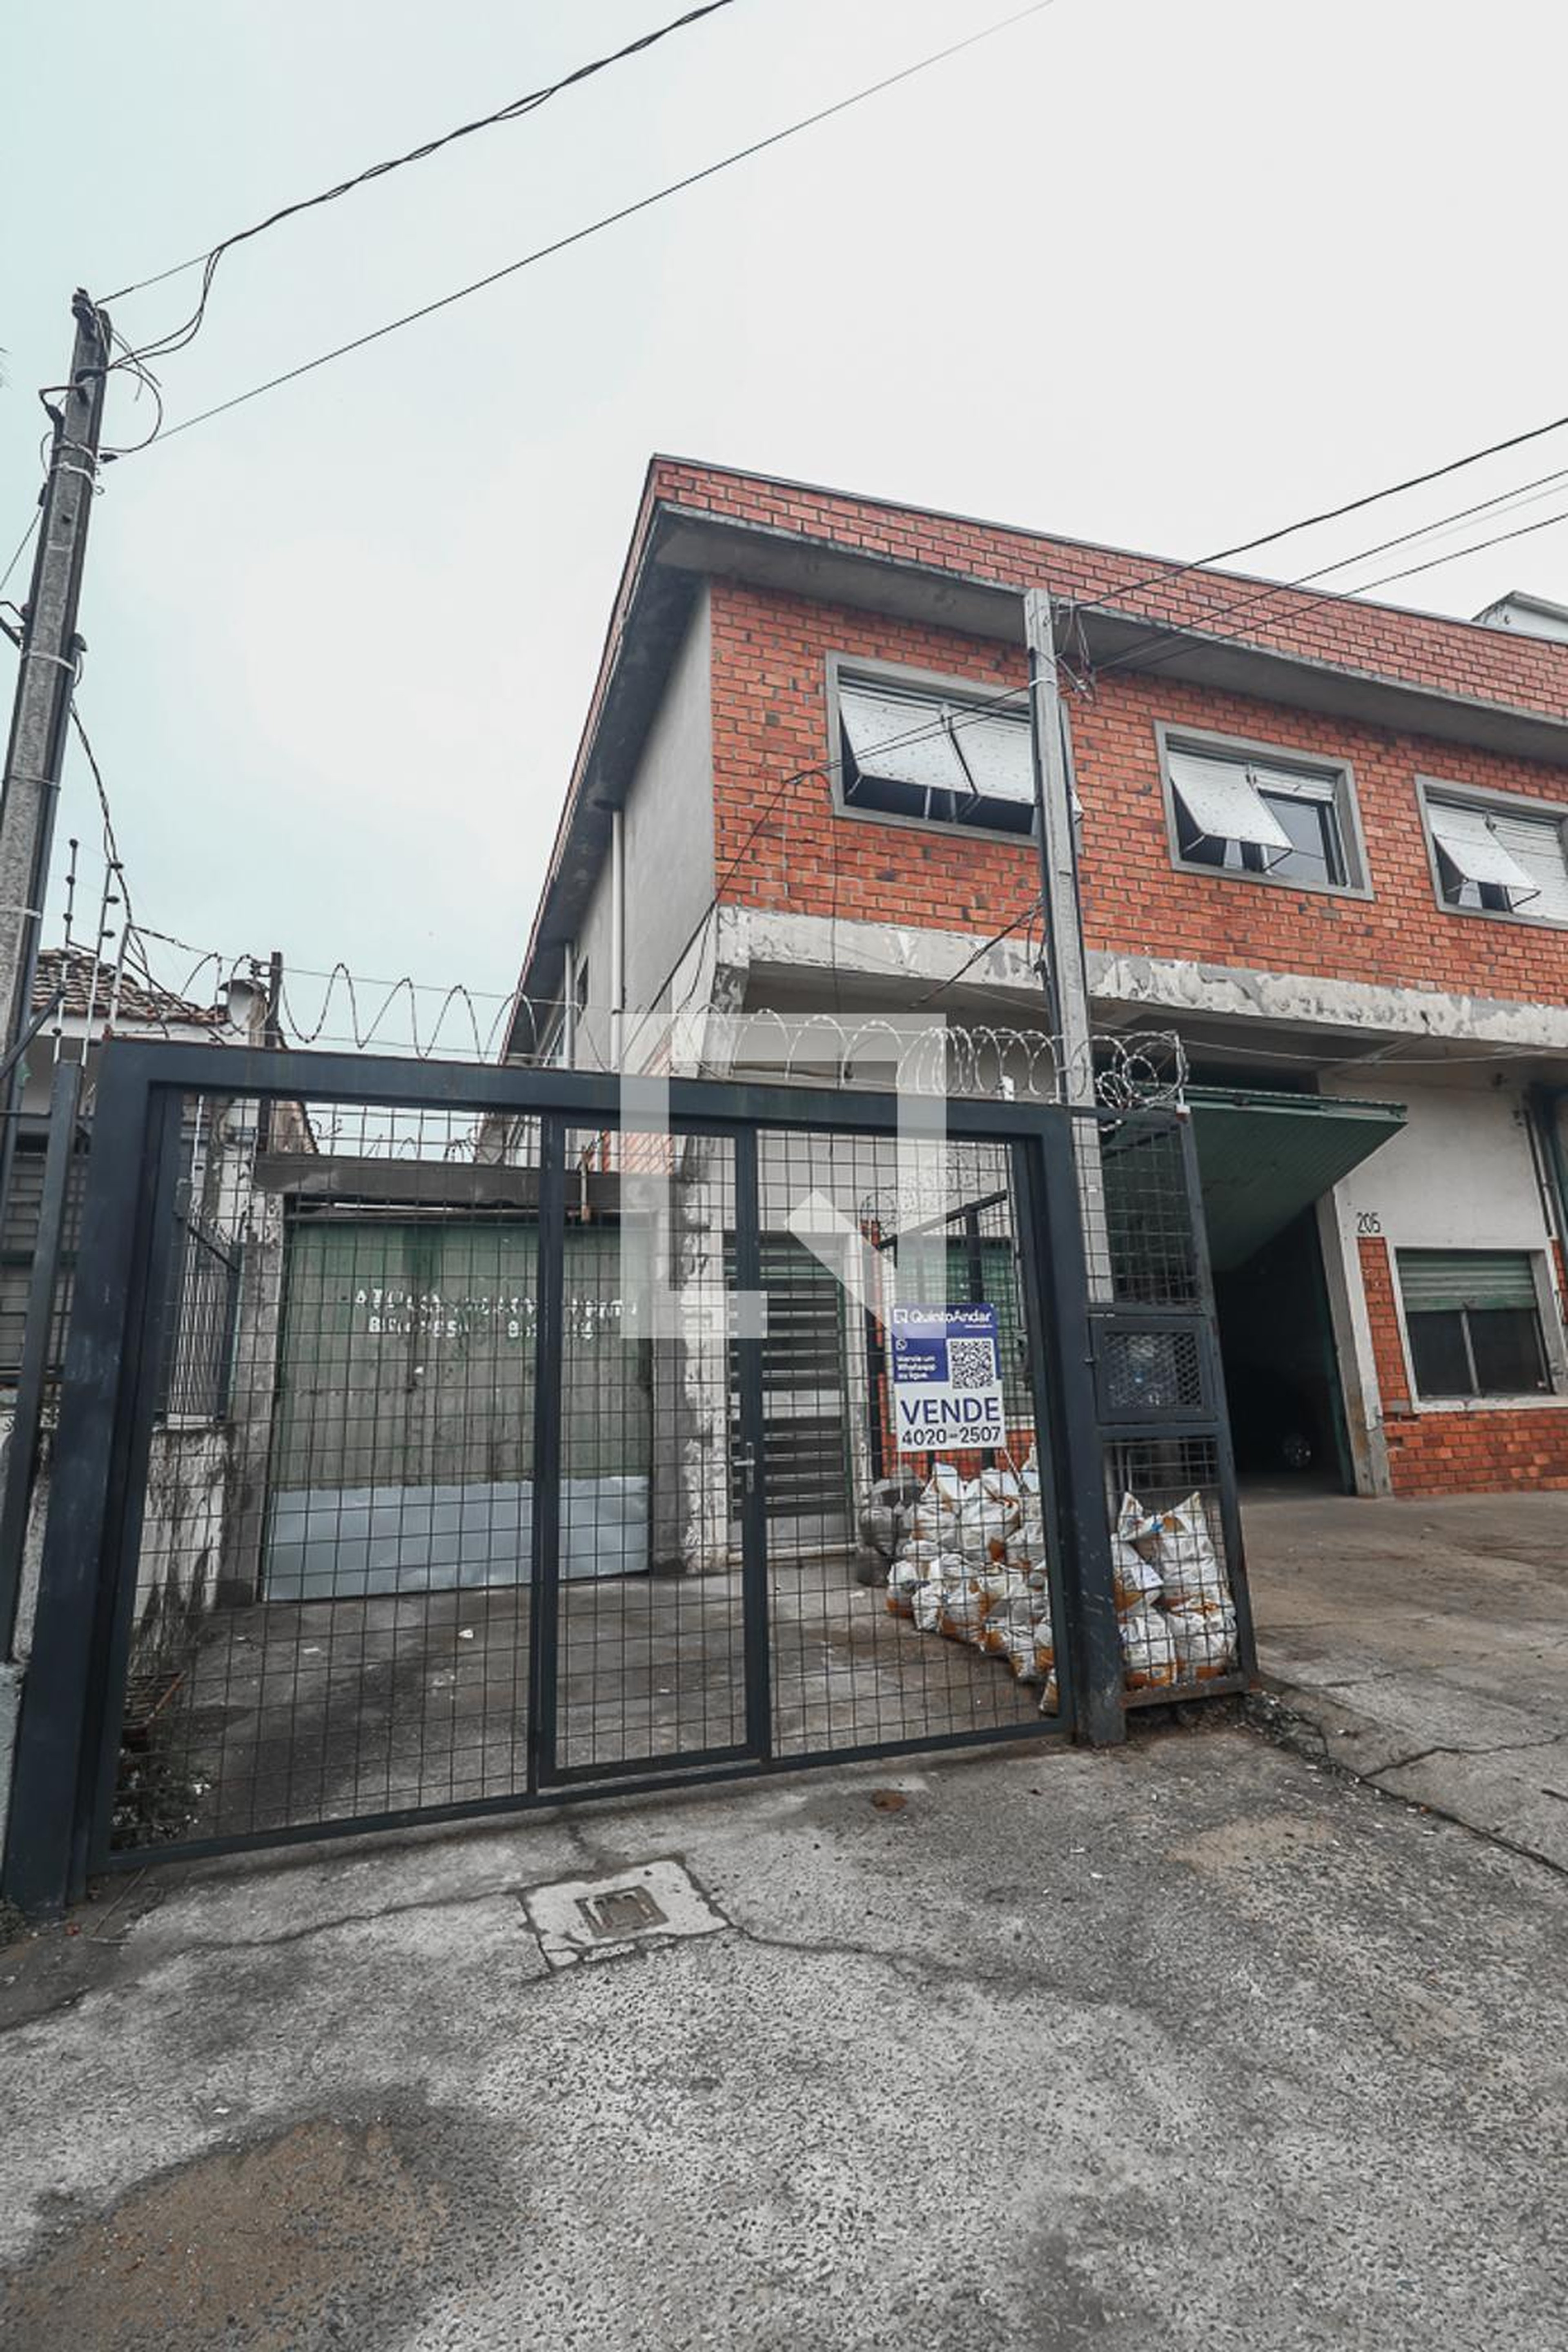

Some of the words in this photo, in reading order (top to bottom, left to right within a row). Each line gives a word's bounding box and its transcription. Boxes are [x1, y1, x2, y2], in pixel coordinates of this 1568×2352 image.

[1356, 1212, 1381, 1233] 205
[909, 1309, 991, 1323] QuintoAndar
[900, 1397, 1000, 1425] VENDE
[902, 1426, 1001, 1446] 4020-2507
